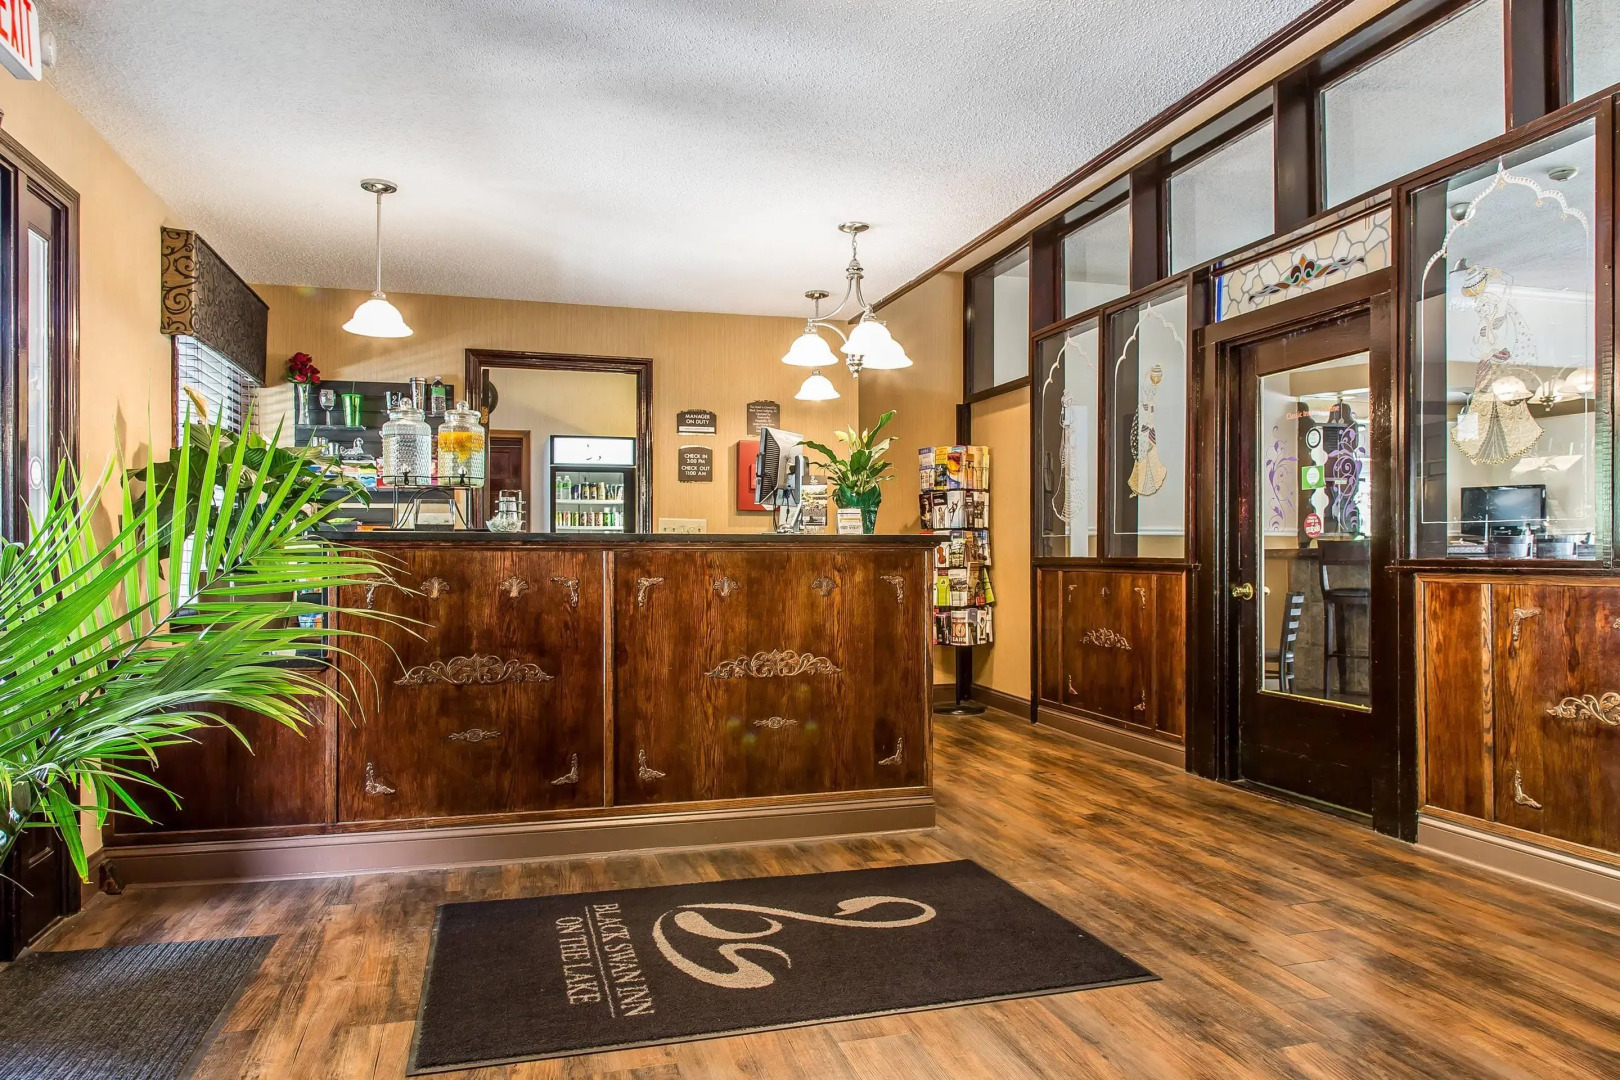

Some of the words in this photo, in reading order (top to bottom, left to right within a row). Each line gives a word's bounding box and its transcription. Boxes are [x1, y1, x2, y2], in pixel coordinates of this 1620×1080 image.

[556, 916, 586, 934] ON
[593, 903, 630, 942] BLACK
[558, 934, 590, 962] THE
[604, 943, 646, 984] SWAN
[563, 962, 601, 1005] LAKE
[616, 984, 655, 1016] INN
